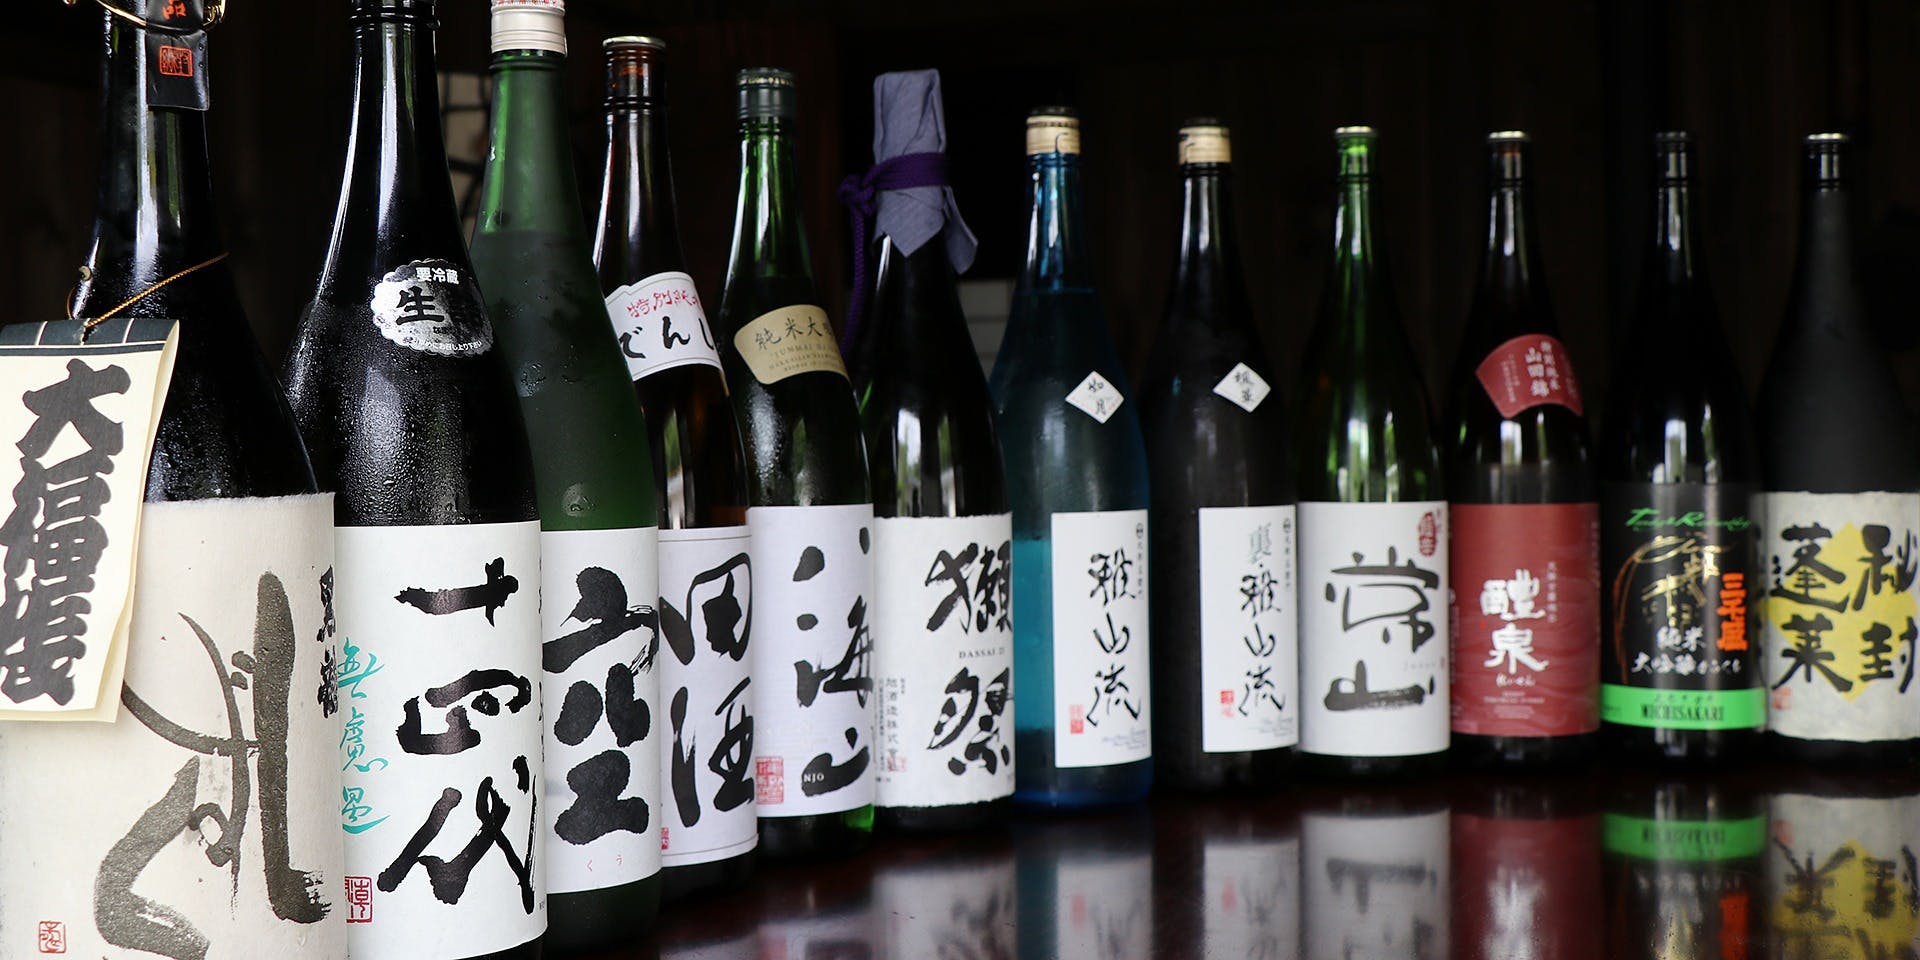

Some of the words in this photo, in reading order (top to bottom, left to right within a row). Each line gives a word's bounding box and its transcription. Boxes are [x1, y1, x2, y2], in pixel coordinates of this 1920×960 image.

[395, 286, 445, 326] 生
[415, 266, 460, 285] 要冷蔵
[1524, 346, 1550, 397] 山田錦
[659, 552, 755, 828] 田酒
[792, 526, 875, 798] 八海山
[1086, 547, 1140, 727] 雅山流
[1324, 546, 1440, 712] 常山
[1479, 568, 1550, 675] 醴泉
[1656, 626, 1707, 651] 純米
[1716, 572, 1748, 651] 三千盛
[1769, 521, 1853, 693] 蓬莱
[1853, 523, 1919, 694] 秘封
[377, 556, 537, 915] 十四代
